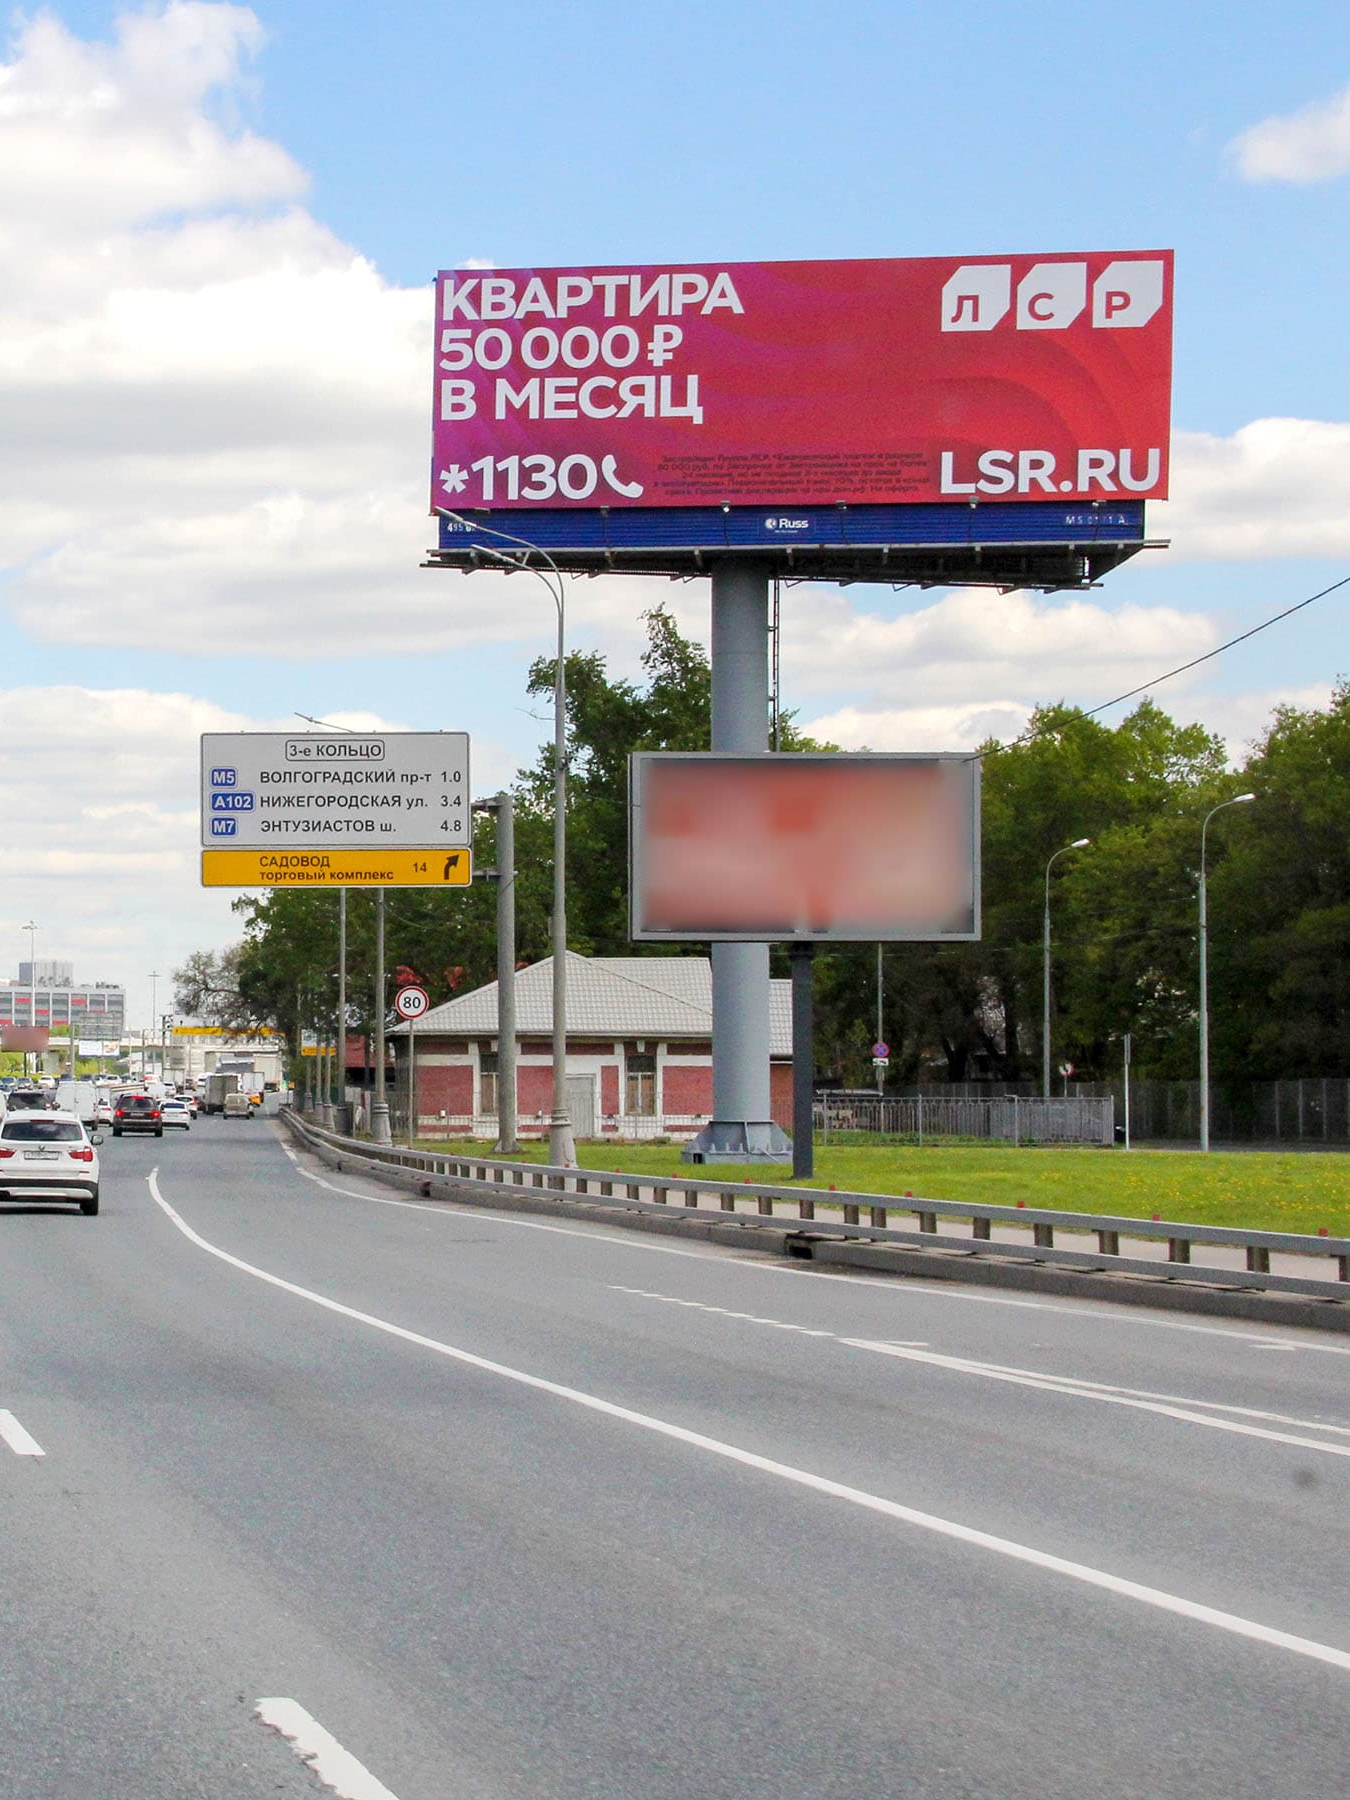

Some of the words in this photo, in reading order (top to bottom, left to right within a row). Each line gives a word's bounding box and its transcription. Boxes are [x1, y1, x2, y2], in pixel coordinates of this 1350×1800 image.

[442, 273, 745, 320] КВАРТИРА
[440, 378, 477, 421] В
[495, 374, 704, 425] МЕСЯЦ
[940, 447, 1161, 494] LSR.RU
[779, 518, 809, 528] Russ
[289, 744, 312, 757] 3-е
[316, 744, 382, 758] КОЛЬЦО
[213, 771, 235, 784] М5
[260, 768, 396, 785] ВОЛГОГРАДСКИЙ
[400, 773, 432, 785] пр-т
[441, 770, 462, 783] 1.0
[214, 795, 252, 808] А102
[260, 795, 402, 809] НИЖЕГОРОДСКАЯ
[406, 797, 428, 810] ул.
[441, 794, 462, 807] 3.4
[213, 820, 235, 833] М7
[261, 820, 375, 832] ЭНТУЗИАСТОВ
[380, 823, 397, 832] ш.
[440, 819, 462, 832] 4.8
[259, 855, 330, 868] САДОВОД
[413, 862, 428, 873] 14
[259, 869, 326, 883] торговый
[329, 870, 394, 881] комплекс
[403, 996, 421, 1009] 80
